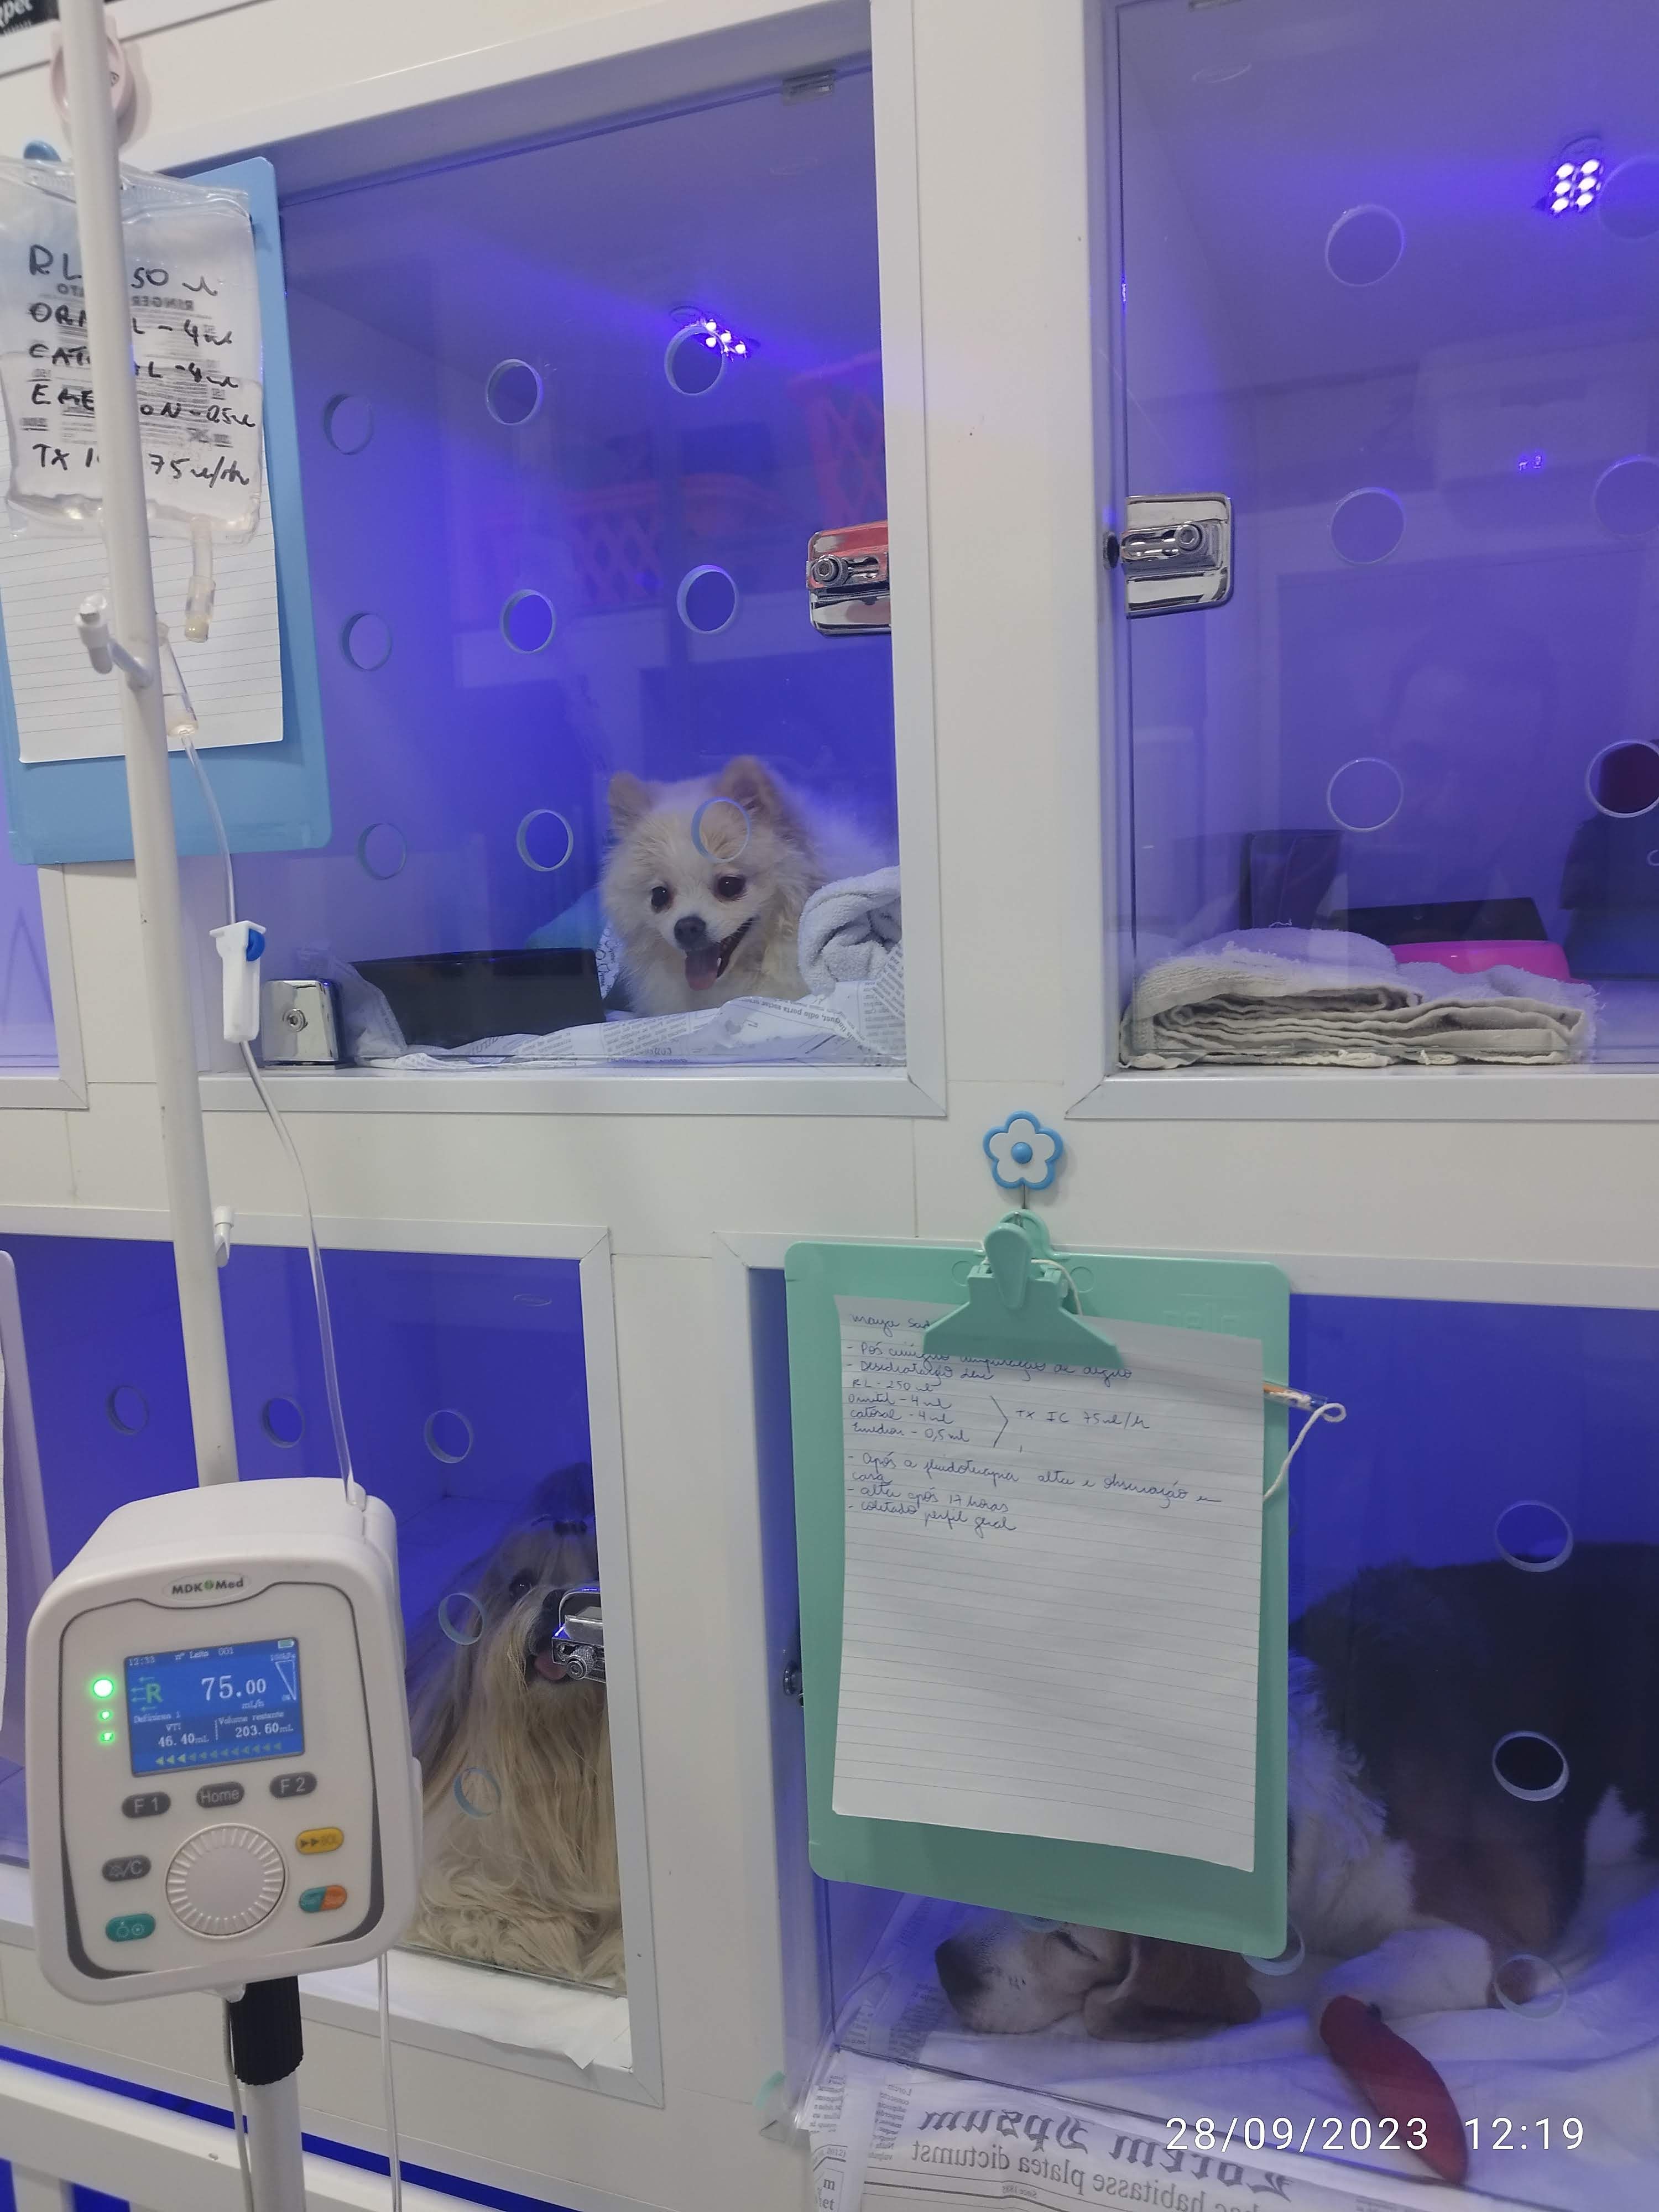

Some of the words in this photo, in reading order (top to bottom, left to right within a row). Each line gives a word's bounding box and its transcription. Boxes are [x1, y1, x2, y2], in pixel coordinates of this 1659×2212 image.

[131, 267, 169, 288] 50
[886, 1380, 911, 1391] 250
[201, 1674, 267, 1702] 75.00
[201, 1788, 241, 1802] Home
